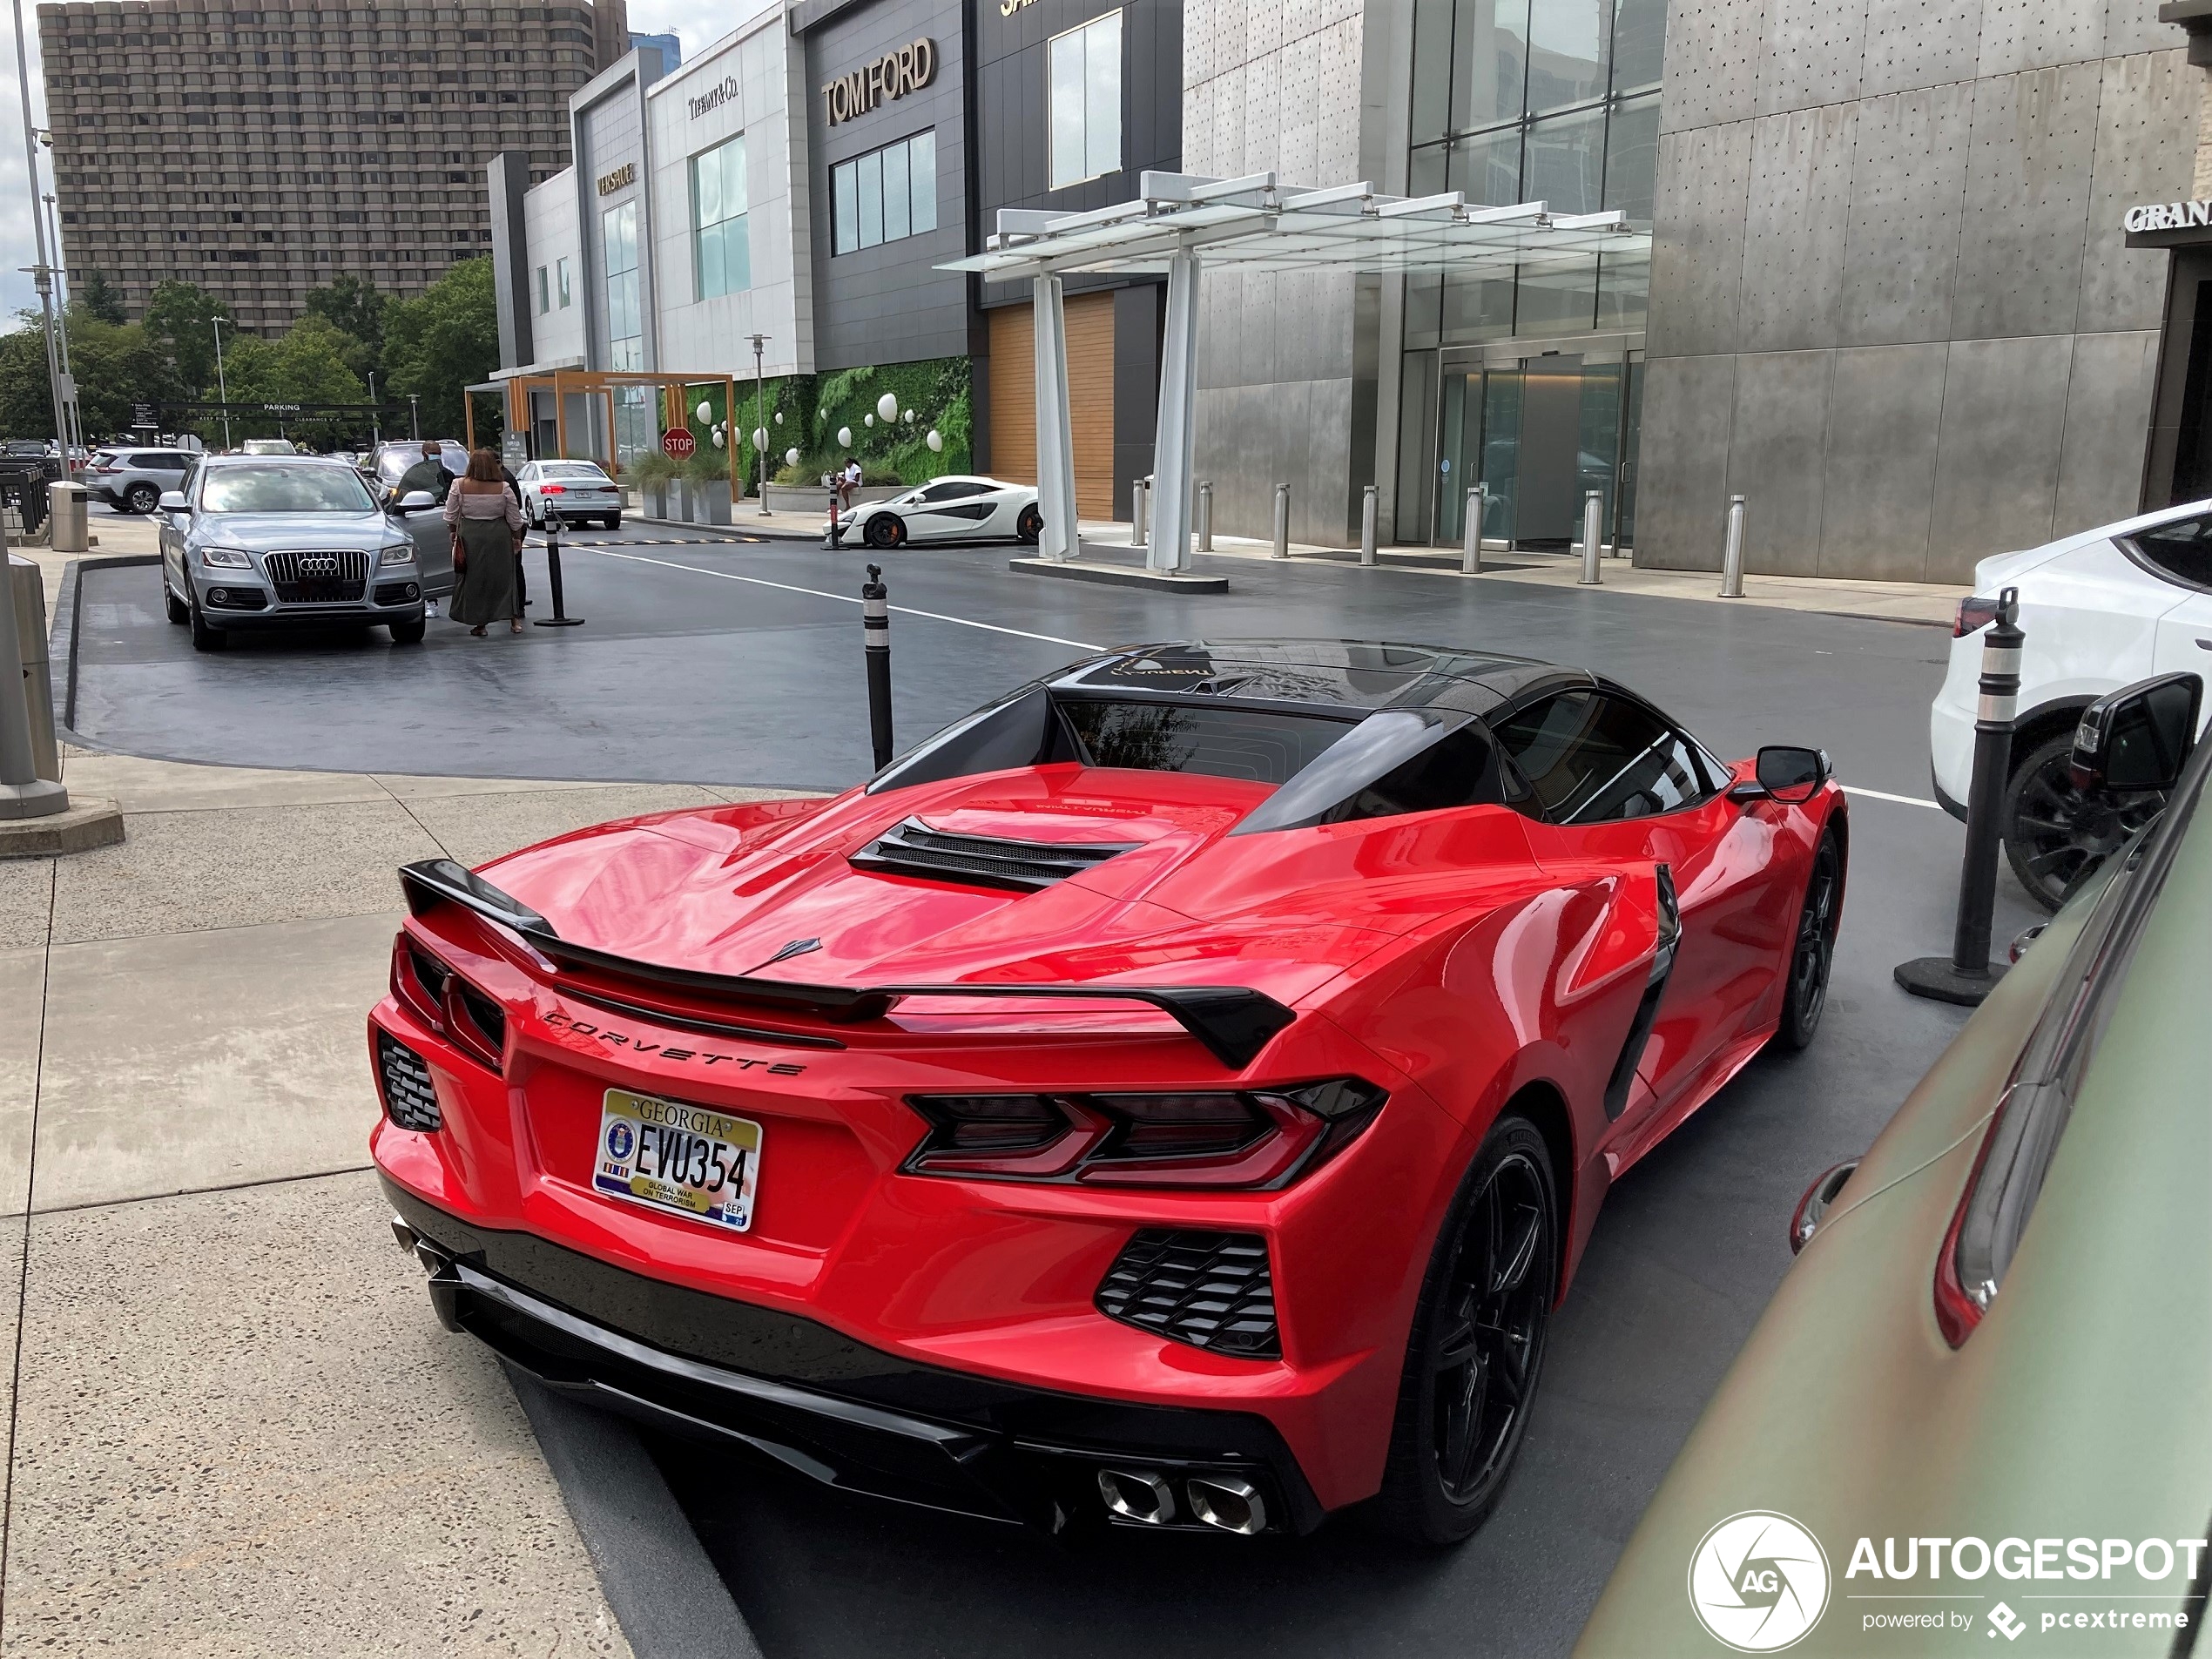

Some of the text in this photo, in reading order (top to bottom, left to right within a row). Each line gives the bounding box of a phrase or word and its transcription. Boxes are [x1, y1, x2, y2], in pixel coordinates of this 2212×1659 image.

[821, 37, 935, 126] TOM FORD
[597, 163, 634, 196] VERSACE
[2124, 199, 2212, 233] GRAN
[664, 438, 693, 451] STOP
[543, 1013, 808, 1076] CORVETTE
[639, 1100, 725, 1138] GEORGIA
[635, 1124, 747, 1200] EVU354
[643, 1188, 696, 1208] ON TERRORISM
[648, 1182, 693, 1199] GLOBAL WAR
[725, 1203, 743, 1215] SEP
